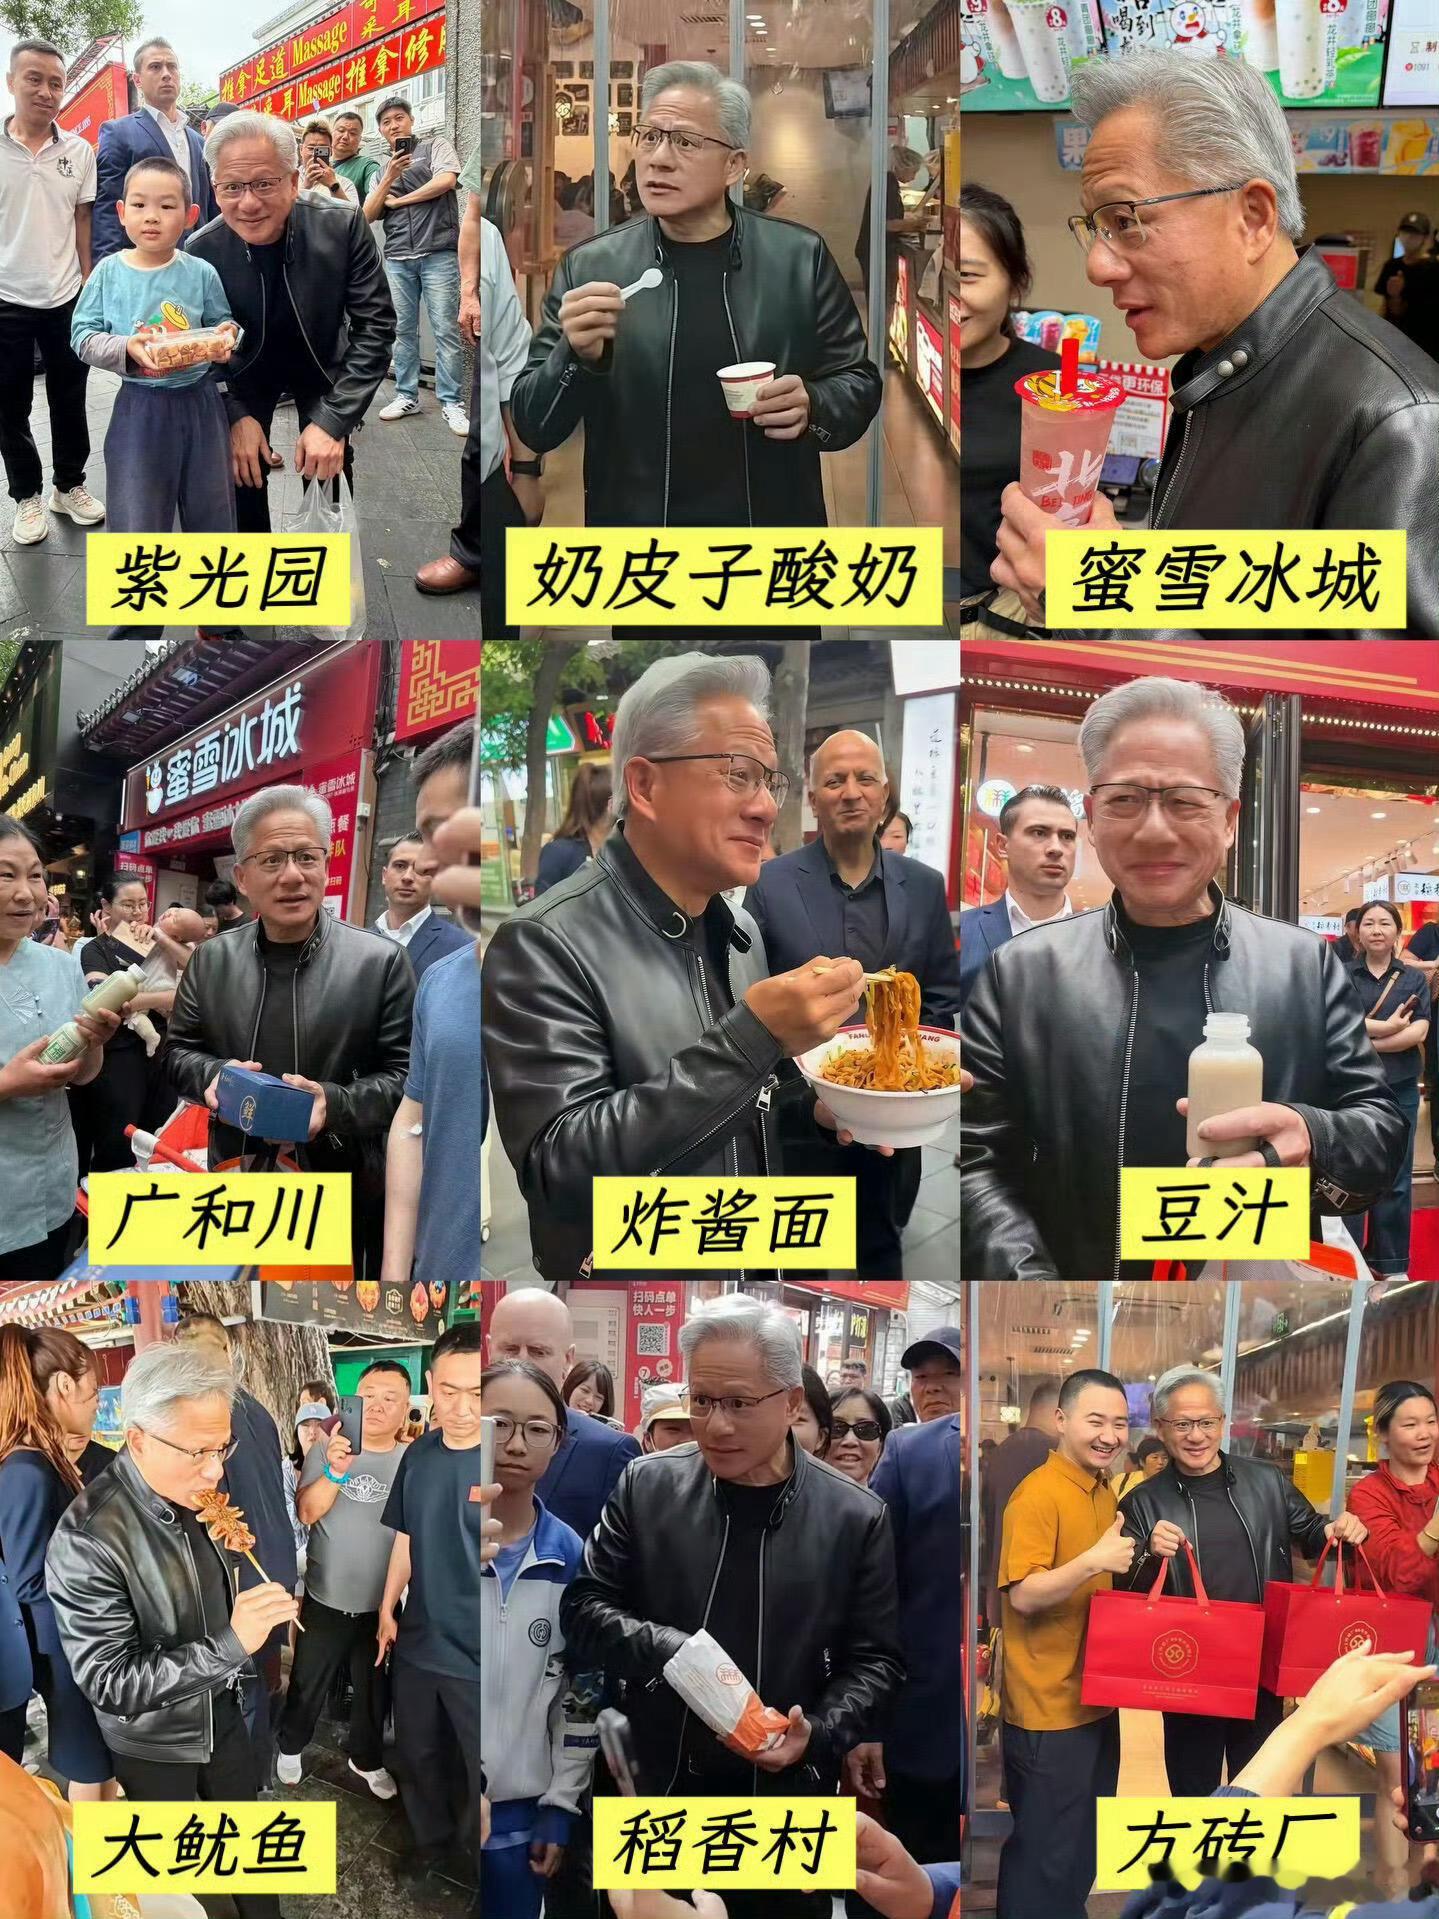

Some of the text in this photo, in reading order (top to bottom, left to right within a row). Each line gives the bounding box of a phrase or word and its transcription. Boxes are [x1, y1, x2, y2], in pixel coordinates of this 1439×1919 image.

[1050, 7, 1062, 28] 8
[221, 45, 289, 102] 推拿足道
[292, 20, 348, 68] Massage
[298, 73, 341, 109] Massage
[165, 682, 302, 806] 蜜雪冰城
[318, 771, 356, 795] 蜜雪冰城
[633, 1291, 677, 1303] 扫码点单
[633, 1304, 676, 1317] 快人一步
